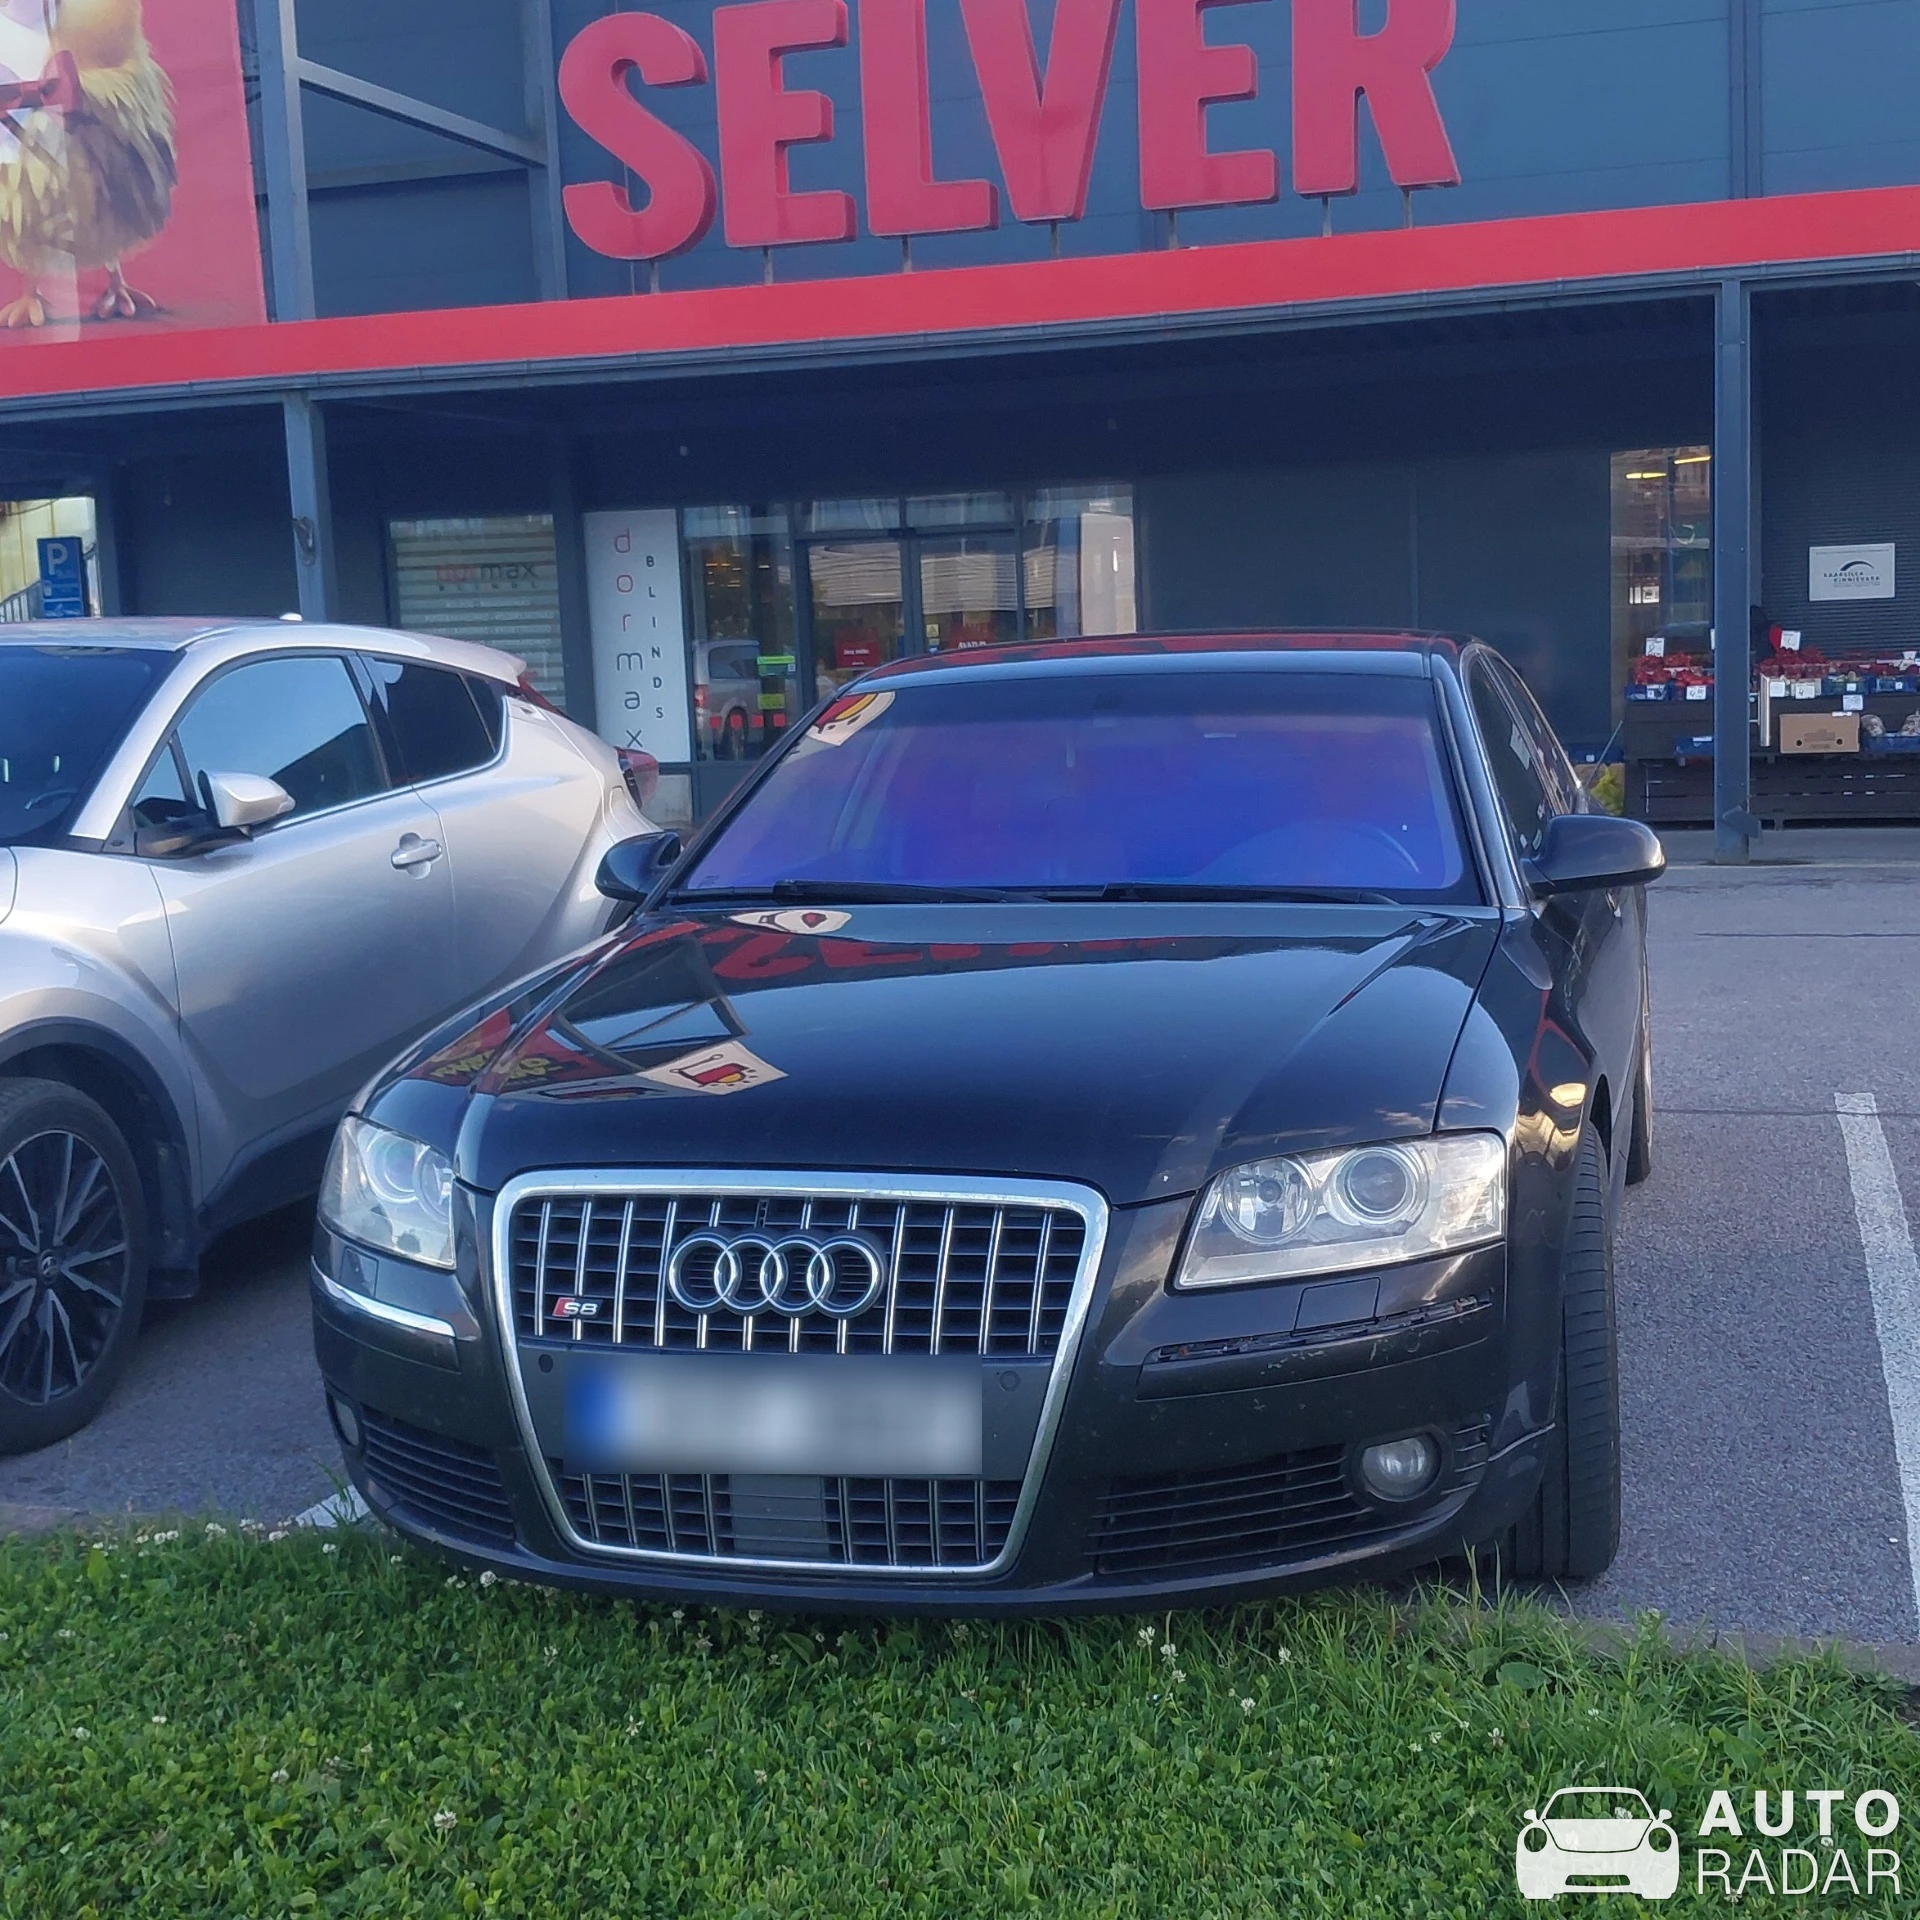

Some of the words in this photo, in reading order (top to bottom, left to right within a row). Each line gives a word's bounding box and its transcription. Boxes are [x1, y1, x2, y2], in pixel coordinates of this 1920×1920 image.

[558, 0, 1461, 262] SELVER
[47, 543, 68, 576] P
[614, 528, 644, 748] dormax
[646, 555, 664, 719] BLINDS
[563, 1302, 598, 1316] S8
